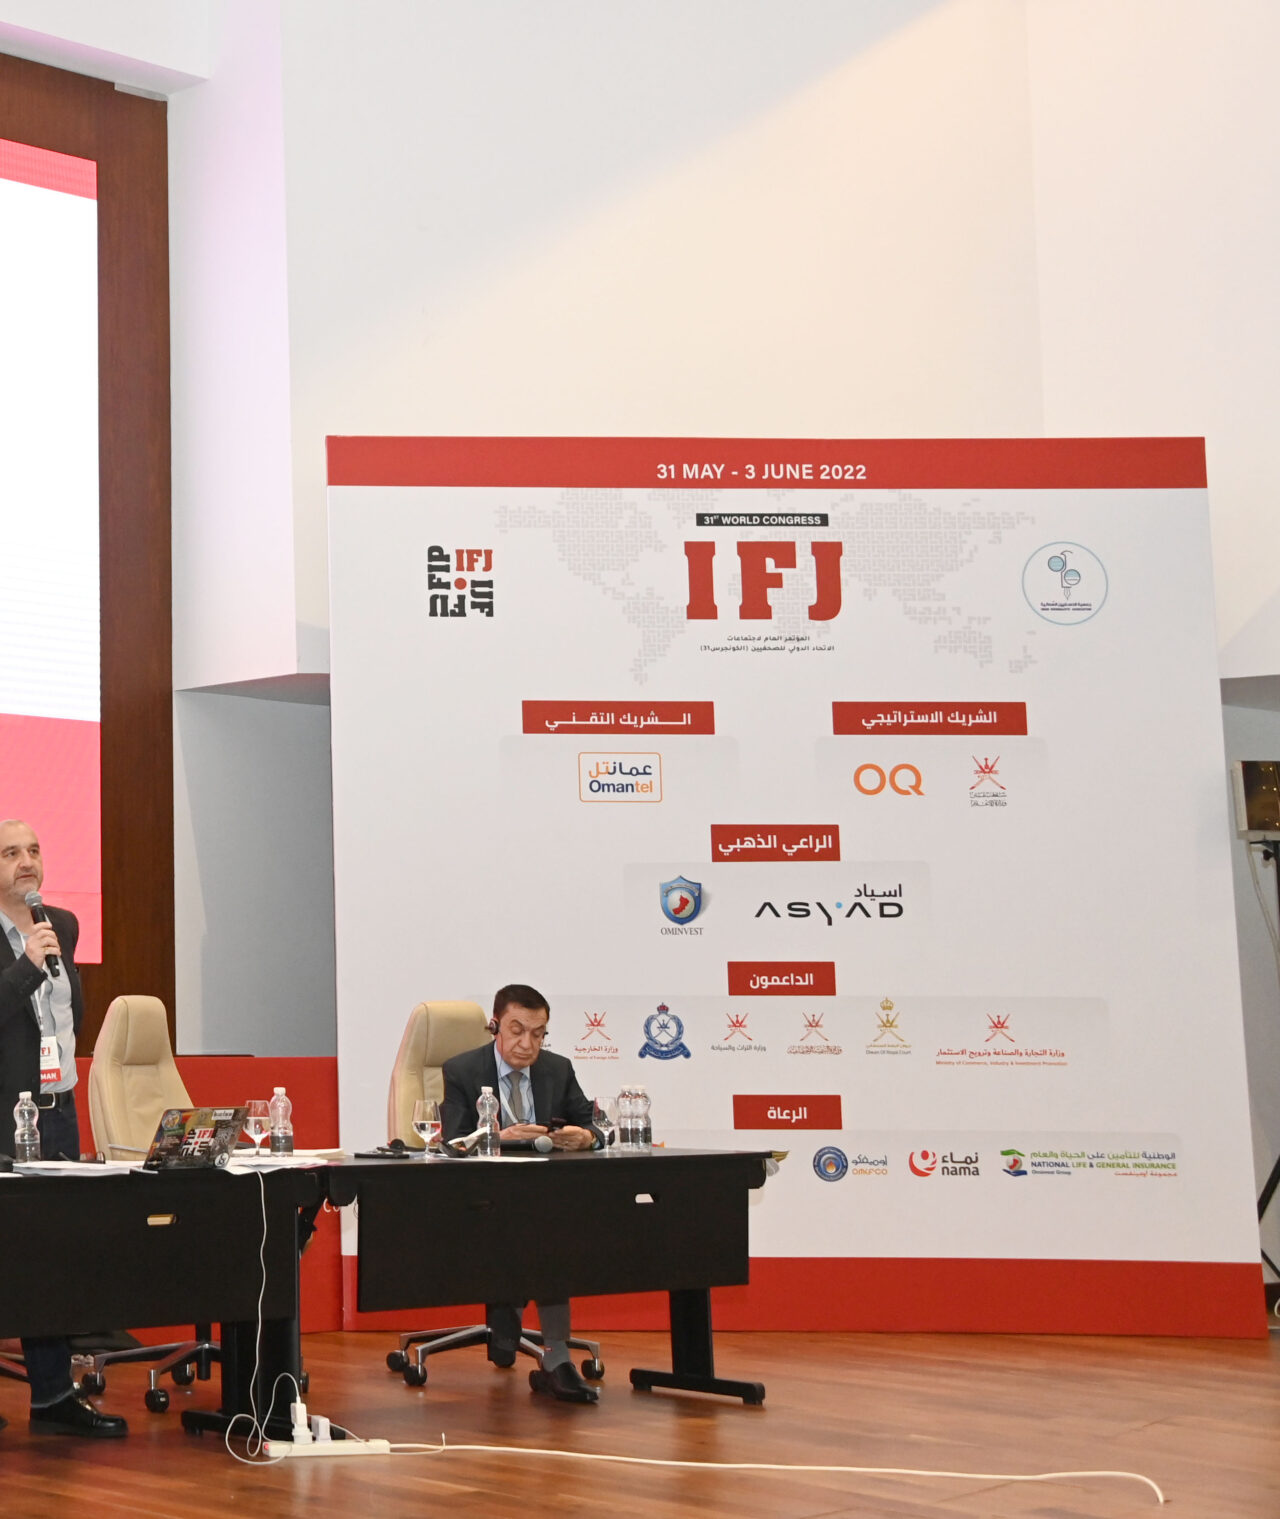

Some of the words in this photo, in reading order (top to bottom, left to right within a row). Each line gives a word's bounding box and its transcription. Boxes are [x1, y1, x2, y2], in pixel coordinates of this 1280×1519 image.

[656, 463, 676, 480] 31
[682, 463, 725, 480] MAY
[744, 463, 756, 480] 3
[762, 464, 814, 480] JUNE
[819, 464, 867, 480] 2022
[721, 516, 760, 525] WORLD
[762, 516, 822, 526] CONGRESS
[455, 549, 493, 572] IFJ
[684, 541, 843, 621] IFJ
[861, 710, 943, 730] الاستراتيجي
[947, 708, 998, 727] الشريك
[588, 779, 654, 793] Omantel
[853, 763, 925, 796] OQ
[718, 834, 778, 856] الذهبي
[782, 834, 833, 856] الراعي
[660, 927, 704, 936] OMINVEST
[749, 972, 814, 990] الداعمون
[767, 1106, 808, 1123] الرعاة
[941, 1166, 980, 1177] nama
[1030, 1161, 1070, 1169] NATIONAL
[1072, 1161, 1088, 1169] LIFE
[1096, 1162, 1130, 1170] GENERAL
[1132, 1162, 1177, 1170] INSURANCE
